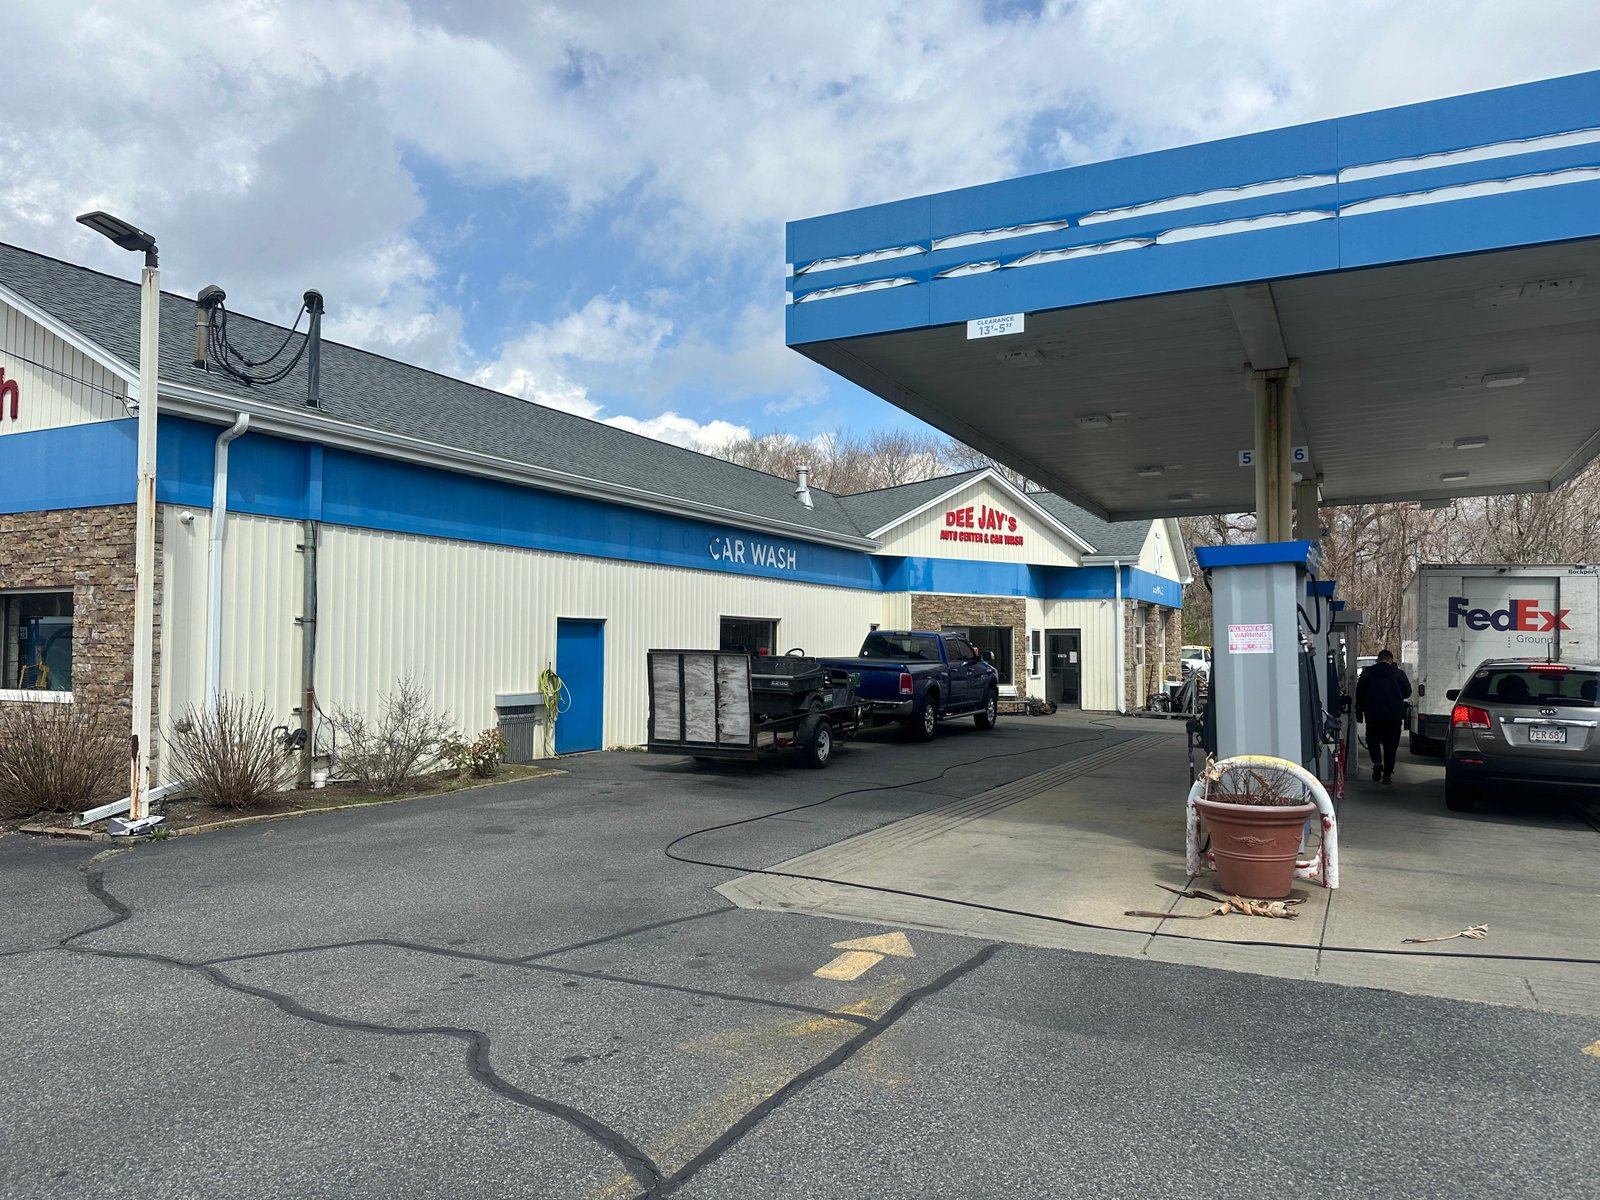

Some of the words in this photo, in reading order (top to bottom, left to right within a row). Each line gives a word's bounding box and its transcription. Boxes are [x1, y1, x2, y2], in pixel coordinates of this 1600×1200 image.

[977, 316, 1015, 326] CLEARANCE
[1242, 452, 1252, 464] 5
[1294, 448, 1305, 460] 6
[945, 506, 975, 528] DEE
[978, 504, 1018, 532] JAY'S
[940, 529, 958, 541] AUTO
[959, 531, 983, 543] CENTER
[984, 533, 989, 544] &
[990, 534, 1003, 545] CAR
[1004, 535, 1024, 546] WASH
[1321, 529, 1328, 537] 2
[709, 537, 746, 564] CAR
[750, 542, 797, 570] WASH
[1448, 597, 1571, 632] FedEx
[1516, 634, 1554, 644] Ground
[1531, 730, 1547, 739] 7ER
[1548, 730, 1564, 740] 687
